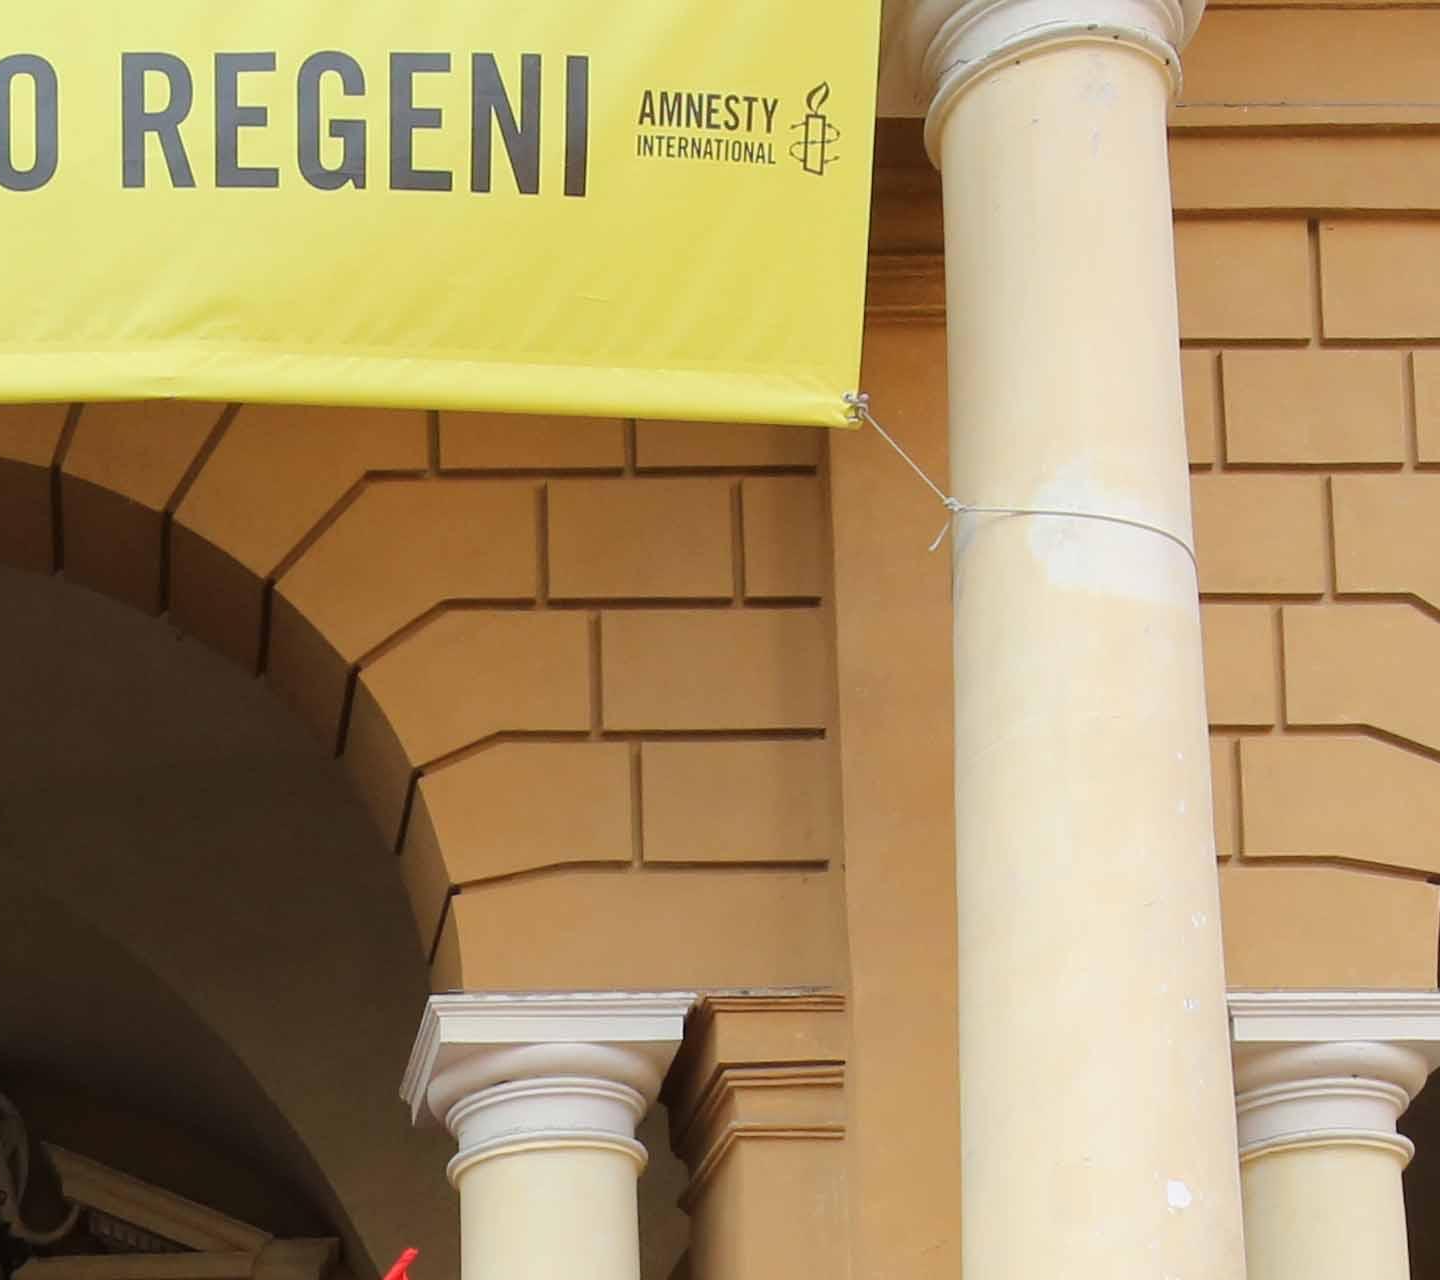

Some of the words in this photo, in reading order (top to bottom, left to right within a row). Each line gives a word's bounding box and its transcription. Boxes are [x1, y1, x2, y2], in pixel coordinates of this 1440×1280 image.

[120, 49, 593, 200] REGENI
[635, 88, 782, 137] AMNESTY
[633, 133, 778, 166] INTERNATIONAL
